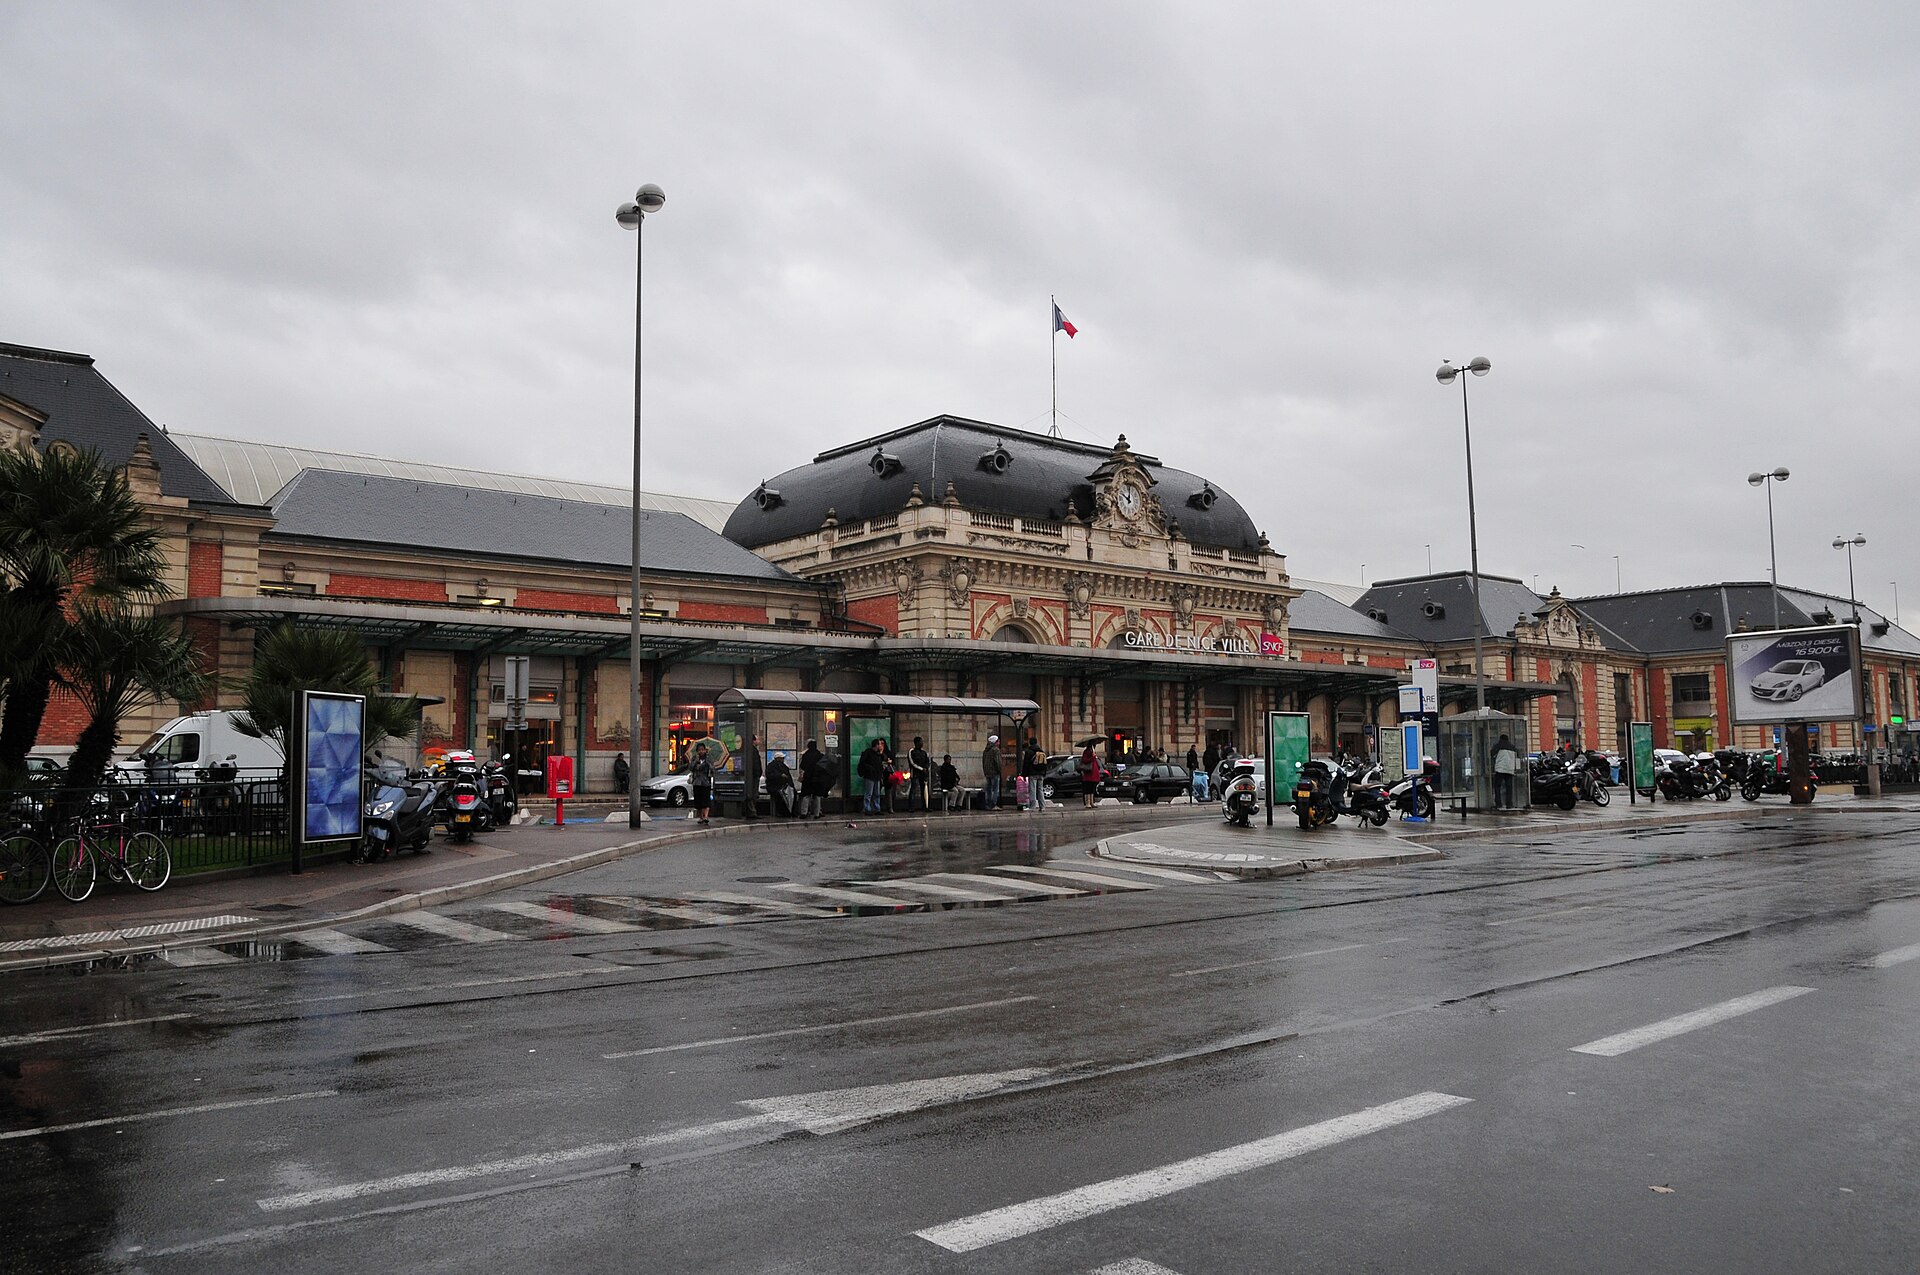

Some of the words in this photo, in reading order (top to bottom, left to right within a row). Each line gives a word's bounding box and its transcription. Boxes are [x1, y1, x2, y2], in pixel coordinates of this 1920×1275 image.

[1125, 631, 1159, 646] GARE
[1165, 634, 1181, 648] DE
[1186, 636, 1217, 651] NICE
[1221, 638, 1250, 652] VILLE
[1262, 641, 1283, 652] SNCF
